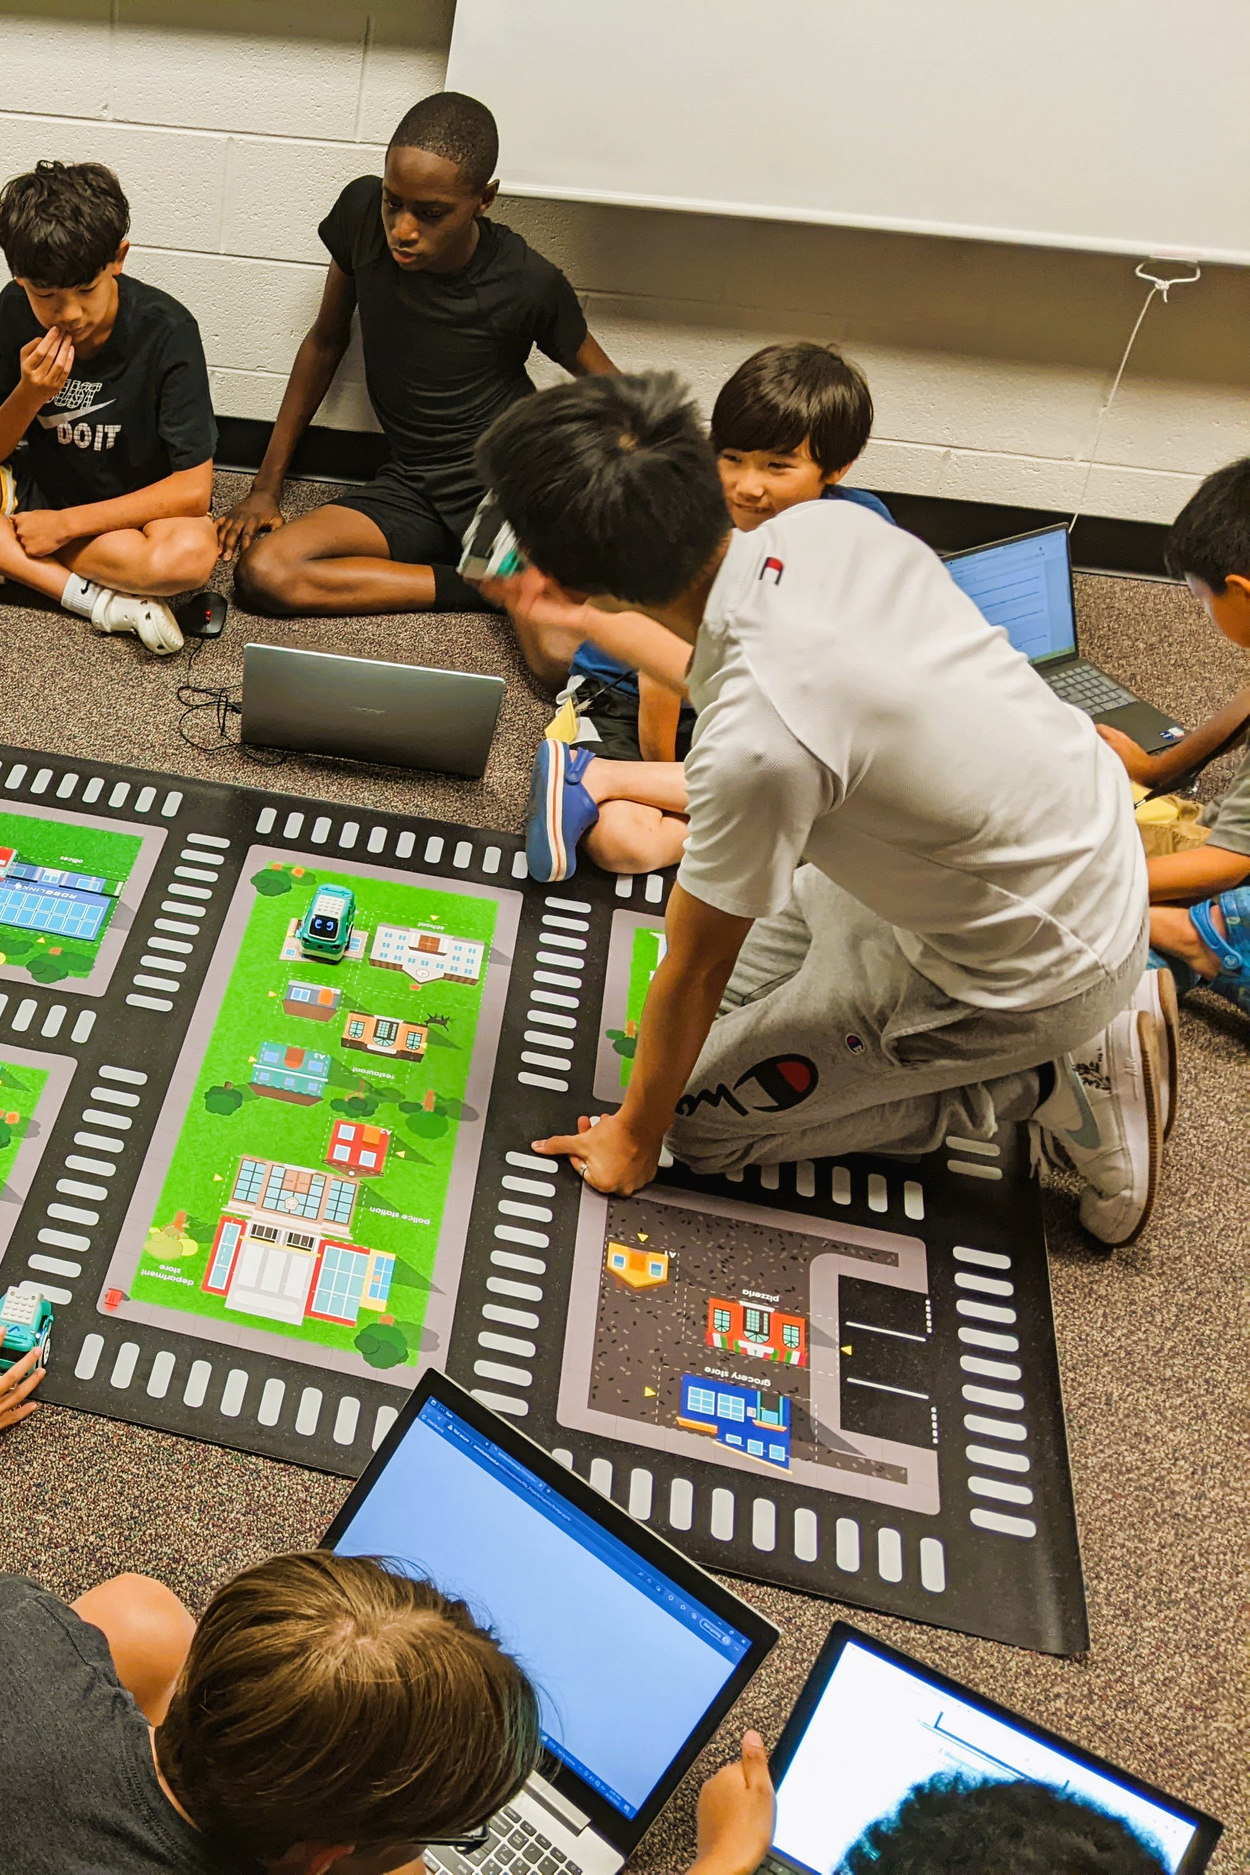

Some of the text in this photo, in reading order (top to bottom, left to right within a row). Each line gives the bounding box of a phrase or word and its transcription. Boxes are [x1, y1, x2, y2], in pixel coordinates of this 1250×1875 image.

[47, 379, 103, 410] UST
[60, 855, 83, 864] offices
[21, 885, 77, 899] ROBOLINK
[418, 921, 444, 930] school
[352, 1067, 395, 1080] restaurant
[369, 1206, 430, 1225] police station
[159, 1264, 182, 1274] store
[141, 1269, 194, 1286] department
[742, 1289, 780, 1303] pizzeria
[704, 1366, 771, 1387] grocery store
